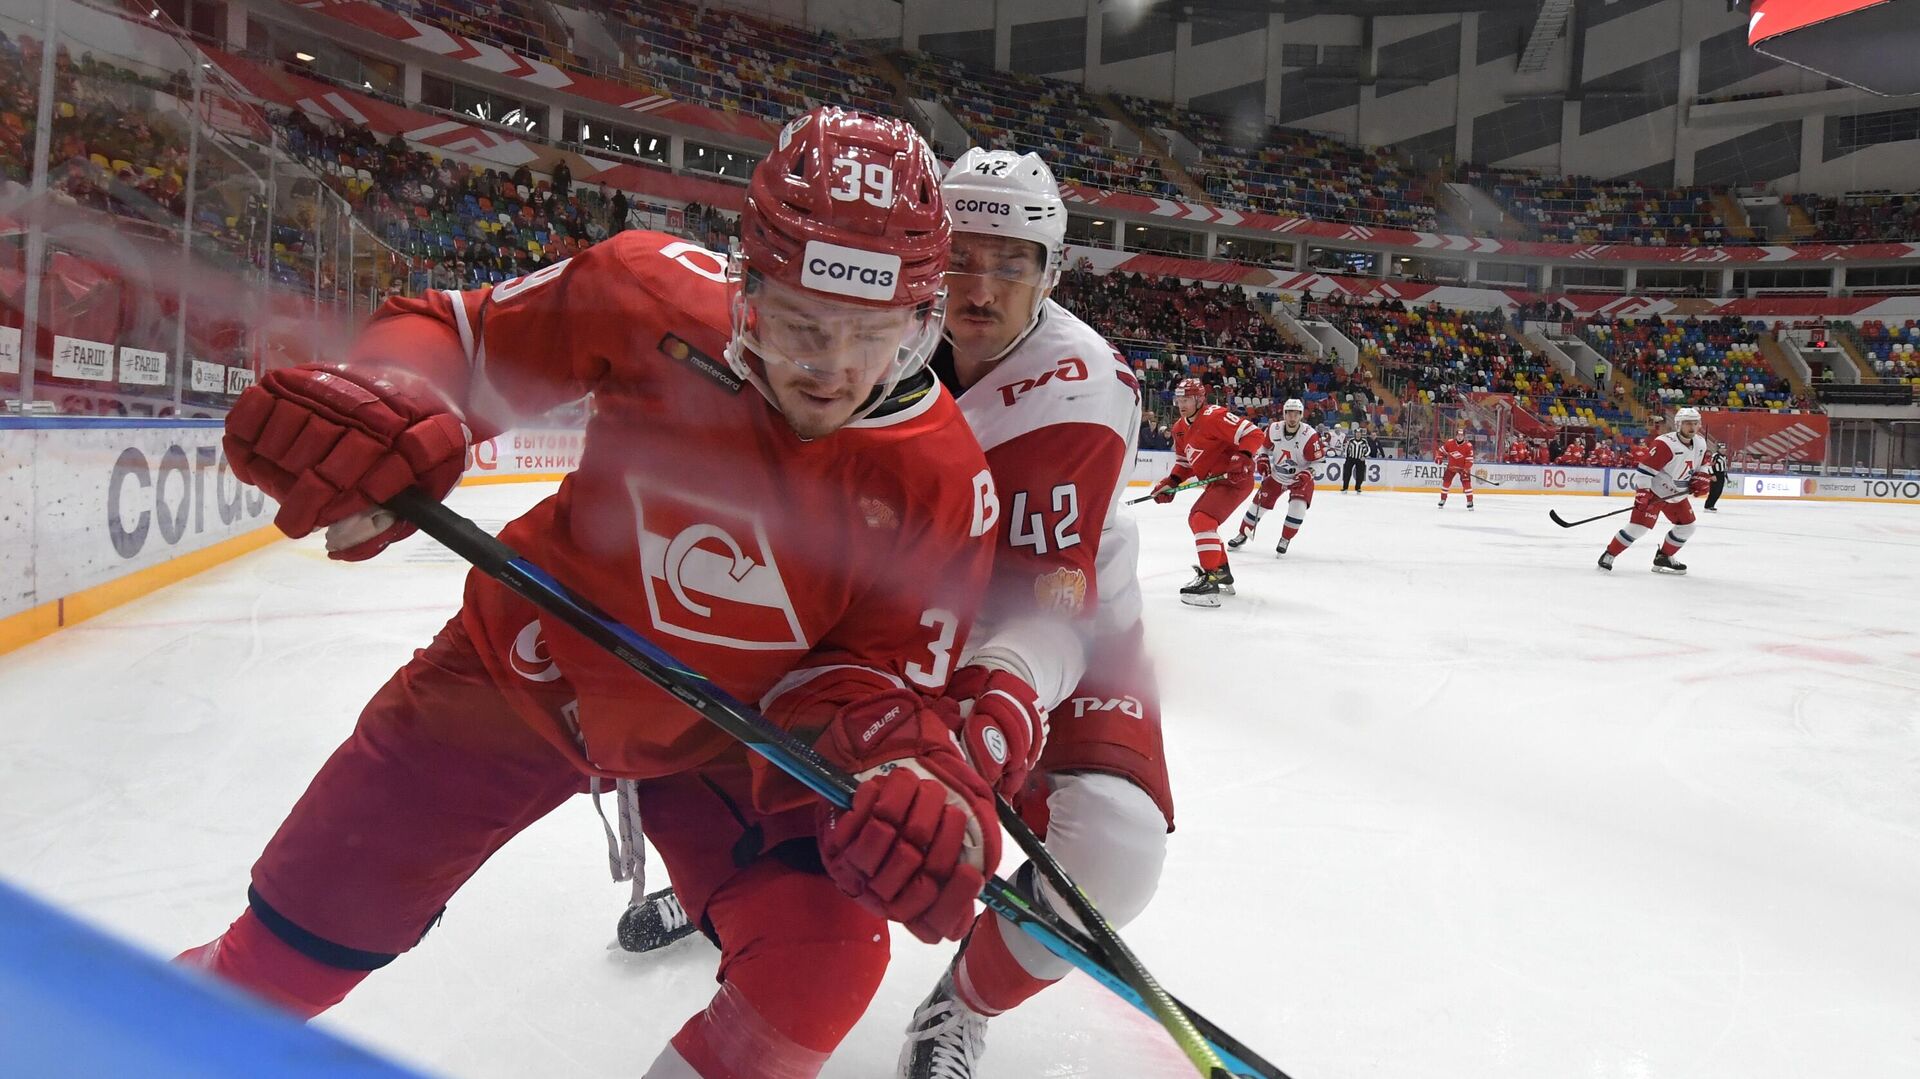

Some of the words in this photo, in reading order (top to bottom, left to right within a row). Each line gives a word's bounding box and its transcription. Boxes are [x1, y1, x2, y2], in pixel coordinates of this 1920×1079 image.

[975, 160, 1008, 176] 42
[830, 157, 893, 209] 39
[954, 199, 1011, 217] согаз
[808, 257, 895, 287] согаз
[690, 355, 741, 392] mastercard
[1223, 412, 1240, 426] 18
[514, 435, 586, 449] БЫТОВА
[515, 455, 579, 468] техник
[1543, 469, 1566, 489] BQ
[107, 444, 265, 559] сога
[1009, 483, 1082, 555] 42
